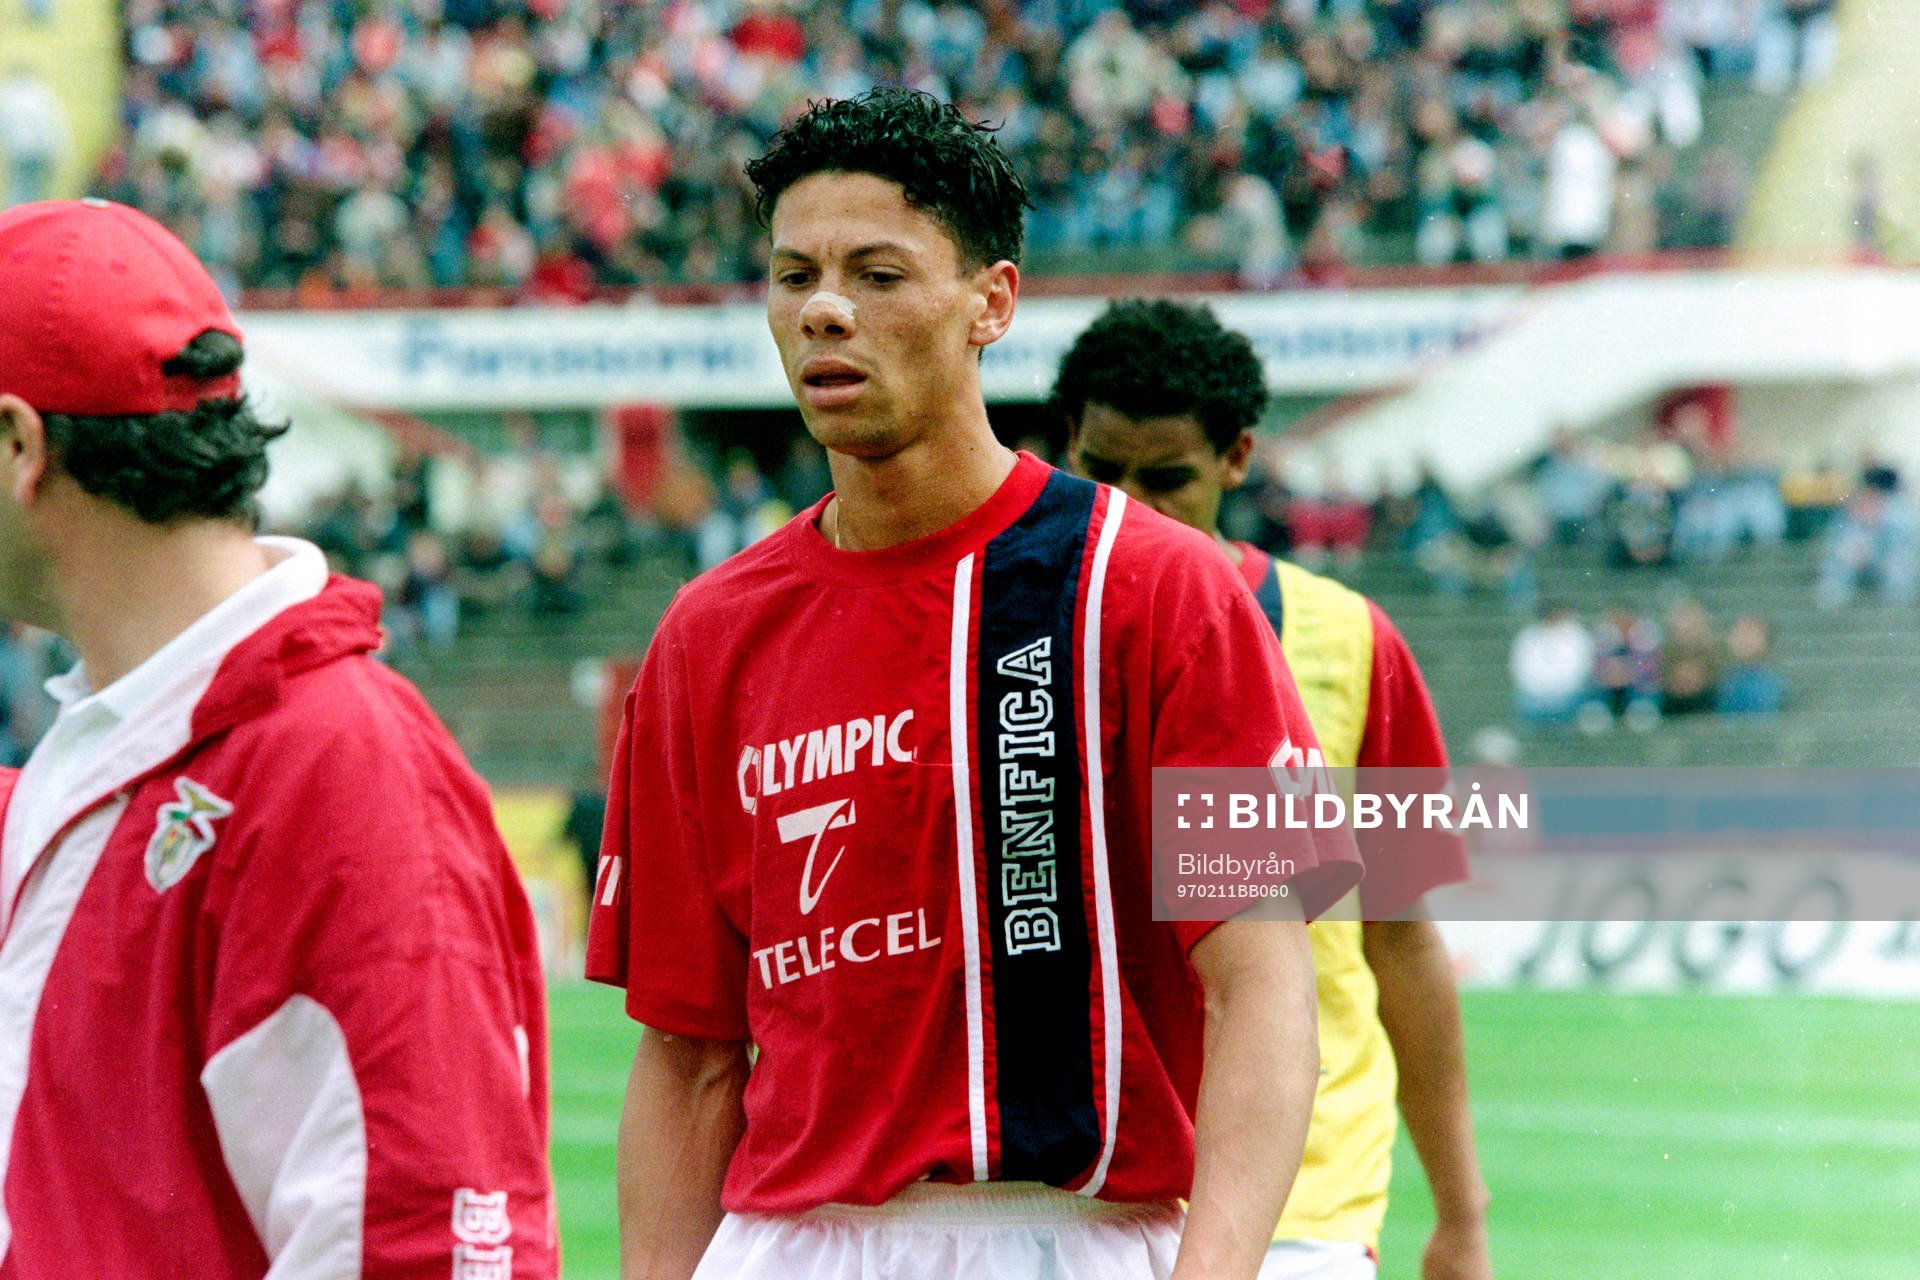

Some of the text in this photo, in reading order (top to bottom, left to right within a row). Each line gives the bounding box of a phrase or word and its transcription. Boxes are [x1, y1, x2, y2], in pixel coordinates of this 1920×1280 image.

[736, 709, 915, 815] OLYMPIC
[997, 636, 1062, 956] BENFICA
[752, 908, 942, 990] TELECEL
